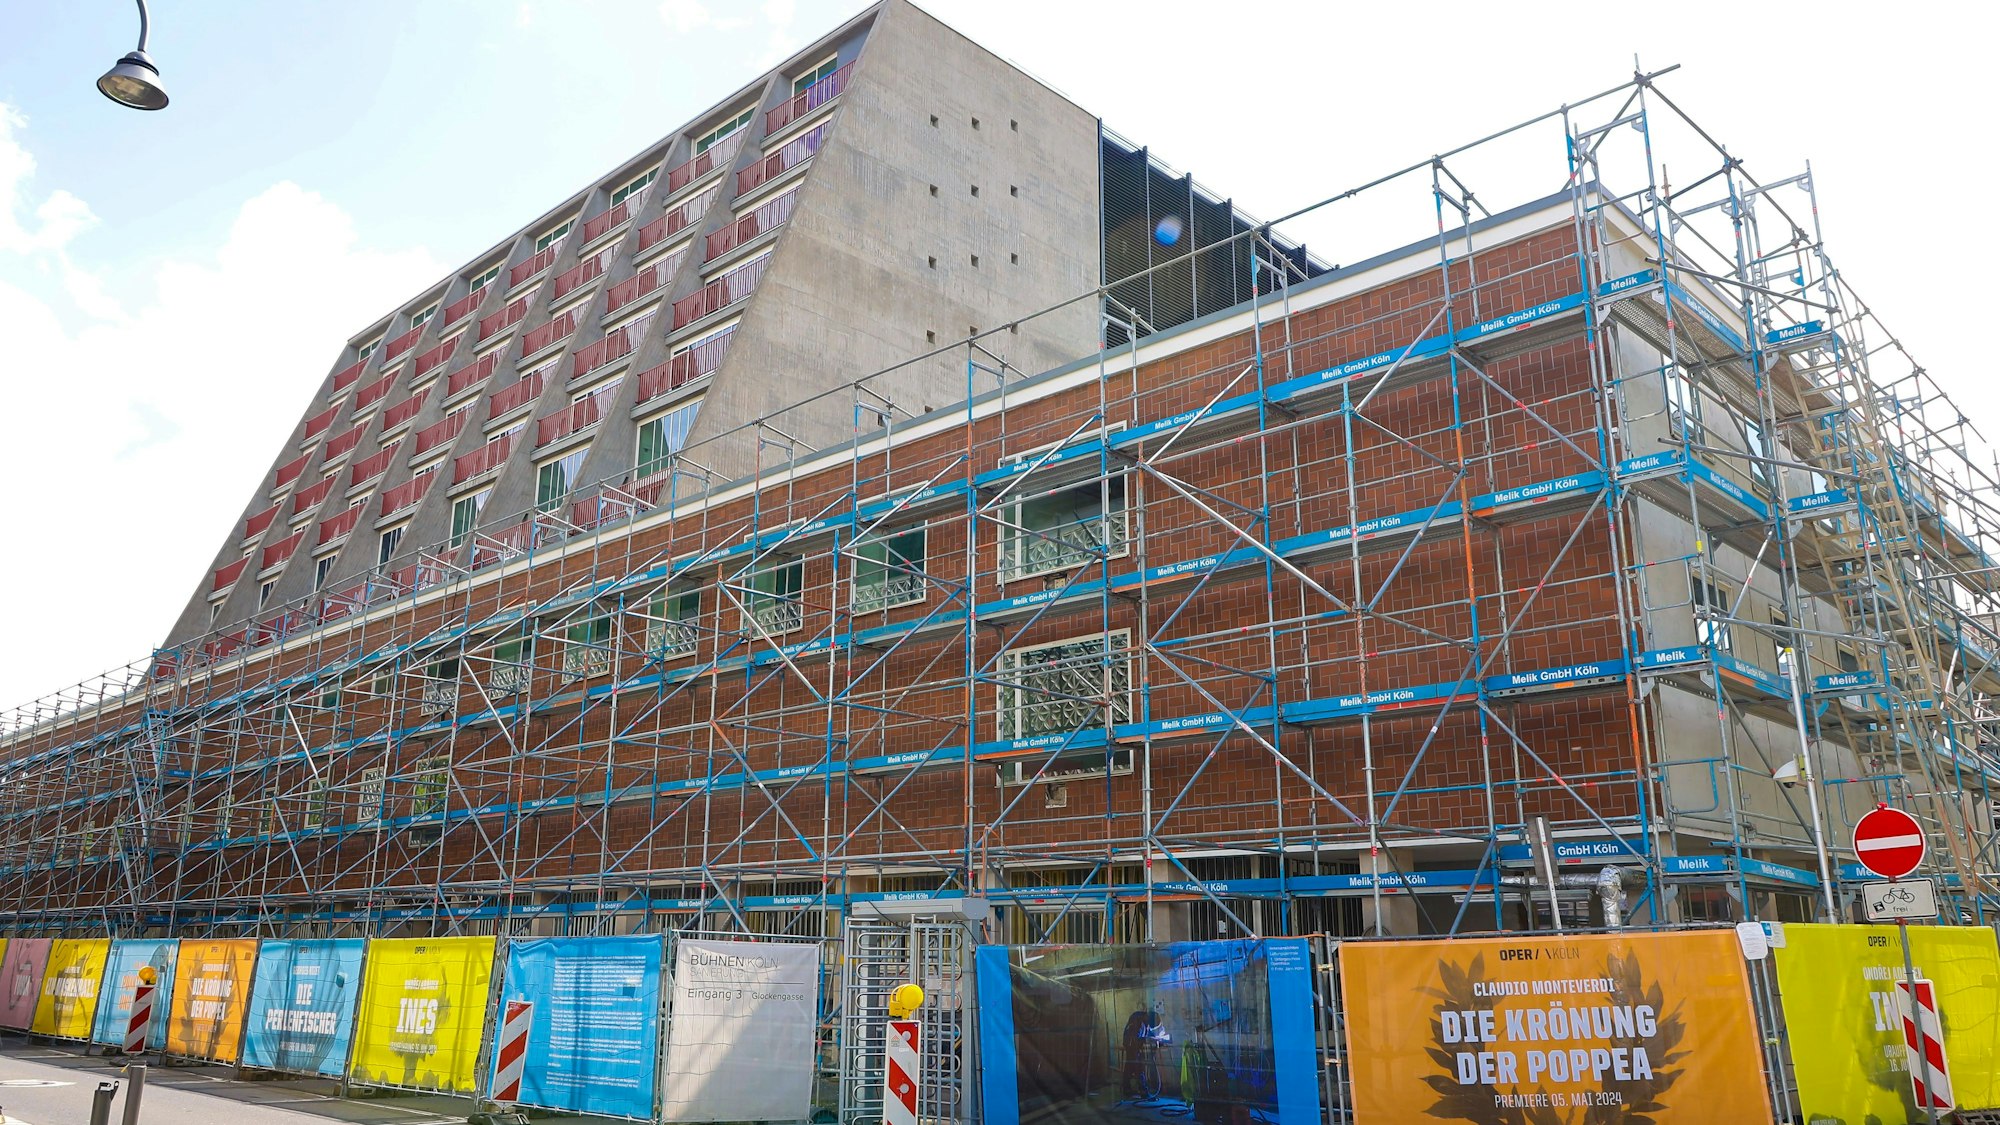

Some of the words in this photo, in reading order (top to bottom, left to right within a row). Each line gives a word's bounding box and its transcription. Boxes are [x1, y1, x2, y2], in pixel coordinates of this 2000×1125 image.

[1611, 276, 1638, 291] Melik
[1480, 319, 1505, 333] Melik
[1507, 310, 1537, 327] GmbH
[1538, 302, 1561, 316] Köln
[1779, 325, 1807, 339] Melik
[1322, 368, 1342, 381] Melik
[1344, 360, 1369, 374] GmbH
[1371, 354, 1390, 366] Köln
[1154, 418, 1172, 430] Melik
[1173, 412, 1195, 425] GmbH
[1013, 463, 1028, 472] Melik
[1632, 457, 1660, 471] Melik
[1494, 489, 1520, 503] Melik
[1521, 482, 1553, 498] GmbH
[1554, 477, 1579, 491] Köln
[1802, 495, 1830, 507] Melik
[1329, 528, 1351, 539] Melik
[1380, 517, 1401, 528] Köln
[1157, 566, 1176, 576] Melik
[1176, 560, 1199, 573] GmbH
[1200, 556, 1217, 568] Köln
[1012, 596, 1028, 606] Melik
[1029, 593, 1048, 603] GmbH
[1655, 650, 1686, 663] Melik
[1511, 673, 1538, 685] Melik
[1540, 668, 1573, 681] GmbH
[1574, 664, 1599, 676] Köln
[1829, 674, 1859, 686] Melik
[1340, 697, 1362, 708] Melik
[1393, 690, 1414, 701] Köln
[1161, 720, 1180, 730] Melik
[1181, 717, 1204, 728] GmbH
[1205, 714, 1223, 725] Köln
[1012, 740, 1028, 749] Melik
[1029, 737, 1049, 747] GmbH
[1050, 735, 1065, 744] Köln
[887, 755, 901, 764] Melik
[901, 753, 918, 762] GmbH
[1557, 844, 1591, 856] GmbH
[1593, 842, 1619, 855] Köln
[1678, 858, 1709, 870] Melik
[1210, 882, 1228, 891] Köln
[1349, 877, 1372, 887] Melik
[1404, 875, 1426, 885] Köln
[898, 893, 915, 901] GmbH
[690, 953, 744, 967] BÜHNEN
[747, 955, 779, 968] KÖLN
[690, 967, 744, 978] SANIERUNG
[192, 977, 204, 996] DIE
[295, 983, 313, 1005] DIE
[687, 988, 732, 1001] Eingang
[736, 990, 742, 999] 3
[752, 992, 804, 1001] Glockengasse
[1473, 980, 1528, 997] CLAUDIO
[1532, 977, 1616, 995] MONTEVERDI
[190, 1000, 204, 1018] DER
[396, 998, 438, 1034] INES
[1869, 991, 1901, 1032] IN
[265, 1008, 337, 1035] PERLENFISCHER
[1440, 1009, 1497, 1044] DIE
[1505, 1001, 1658, 1042] KRÖNUNG
[1456, 1051, 1519, 1085] DER
[1526, 1047, 1654, 1083] POPPEA
[1494, 1094, 1549, 1109] PREMIERE
[1551, 1093, 1569, 1107] 05.
[1572, 1093, 1594, 1106] MAI
[1596, 1092, 1623, 1106] 2024
